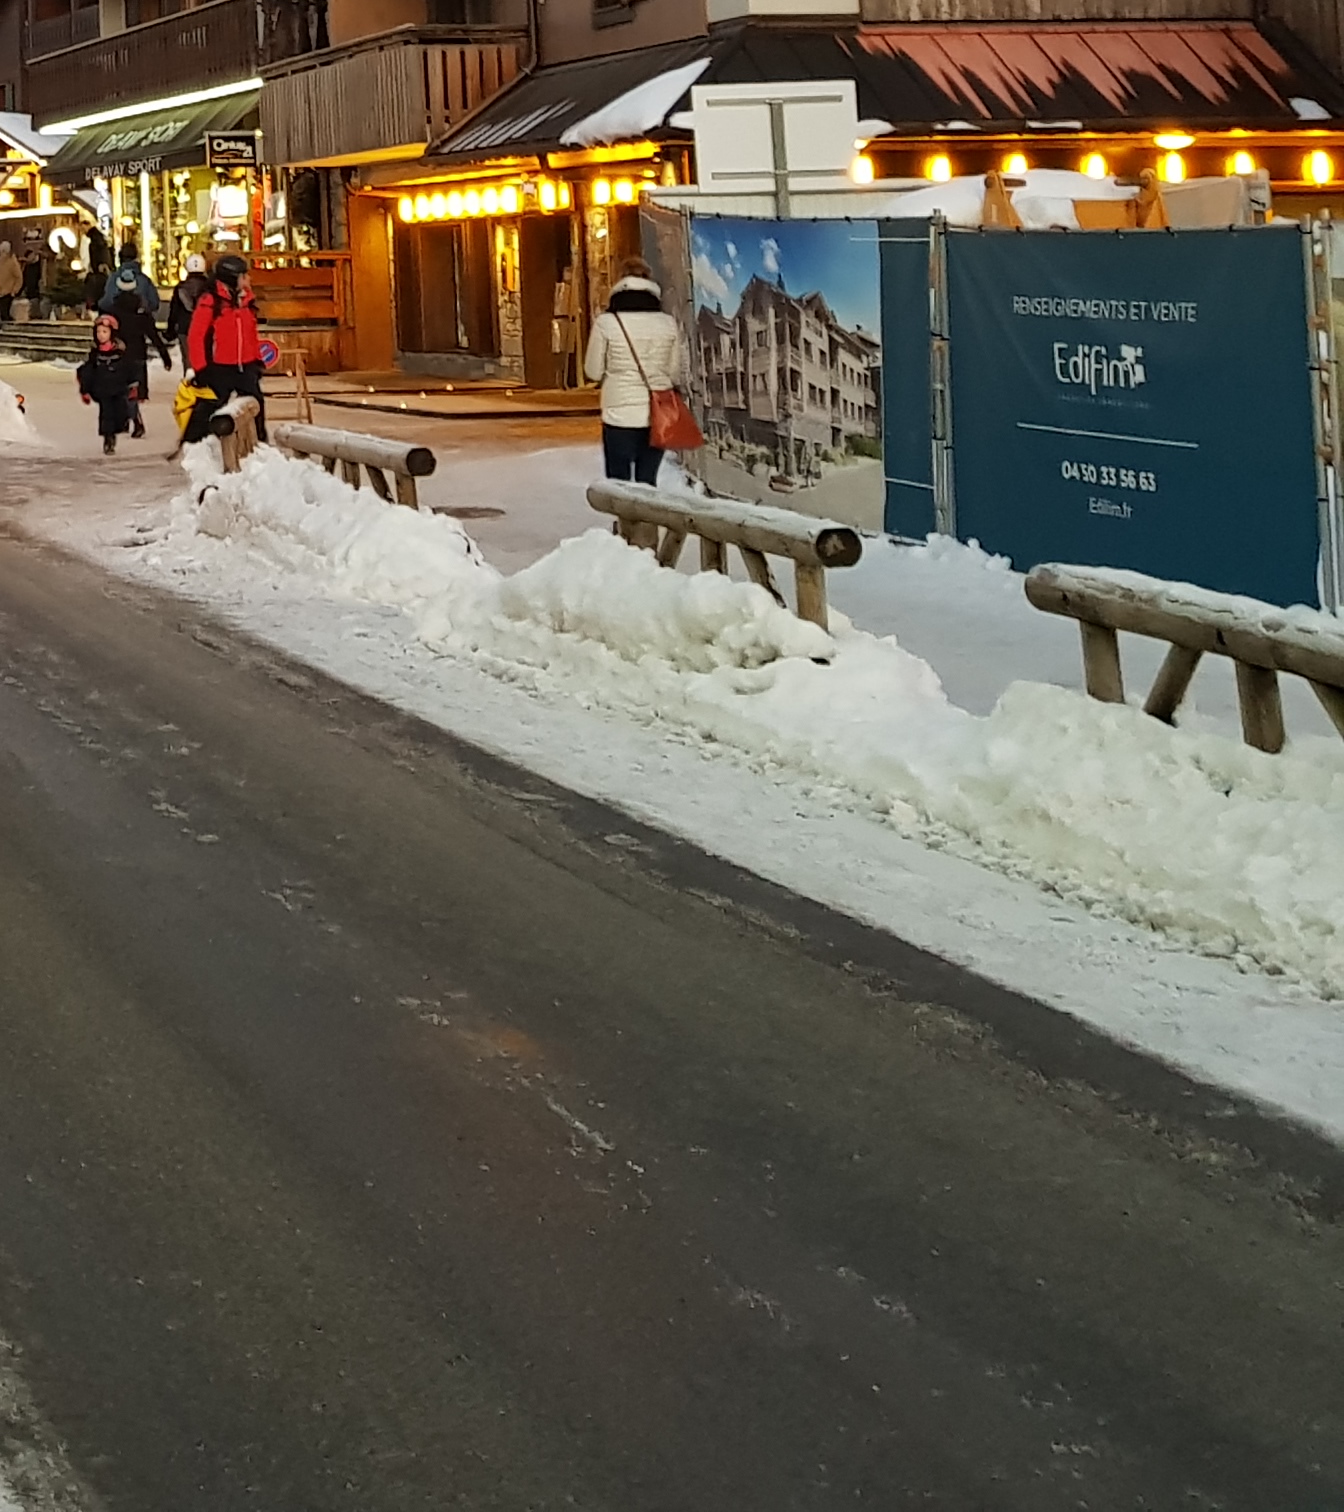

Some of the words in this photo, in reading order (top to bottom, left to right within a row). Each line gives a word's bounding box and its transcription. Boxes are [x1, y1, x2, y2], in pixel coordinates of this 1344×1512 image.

[85, 162, 126, 180] DELAVAY
[128, 157, 162, 176] SPORT
[1013, 295, 1128, 320] RENSEIGNEMENTS
[1130, 300, 1149, 320] ET
[1151, 301, 1198, 322] VENTE
[1053, 342, 1137, 395] Edifim
[1100, 466, 1117, 486] 33
[1120, 468, 1137, 489] 56
[1139, 471, 1157, 492] 63
